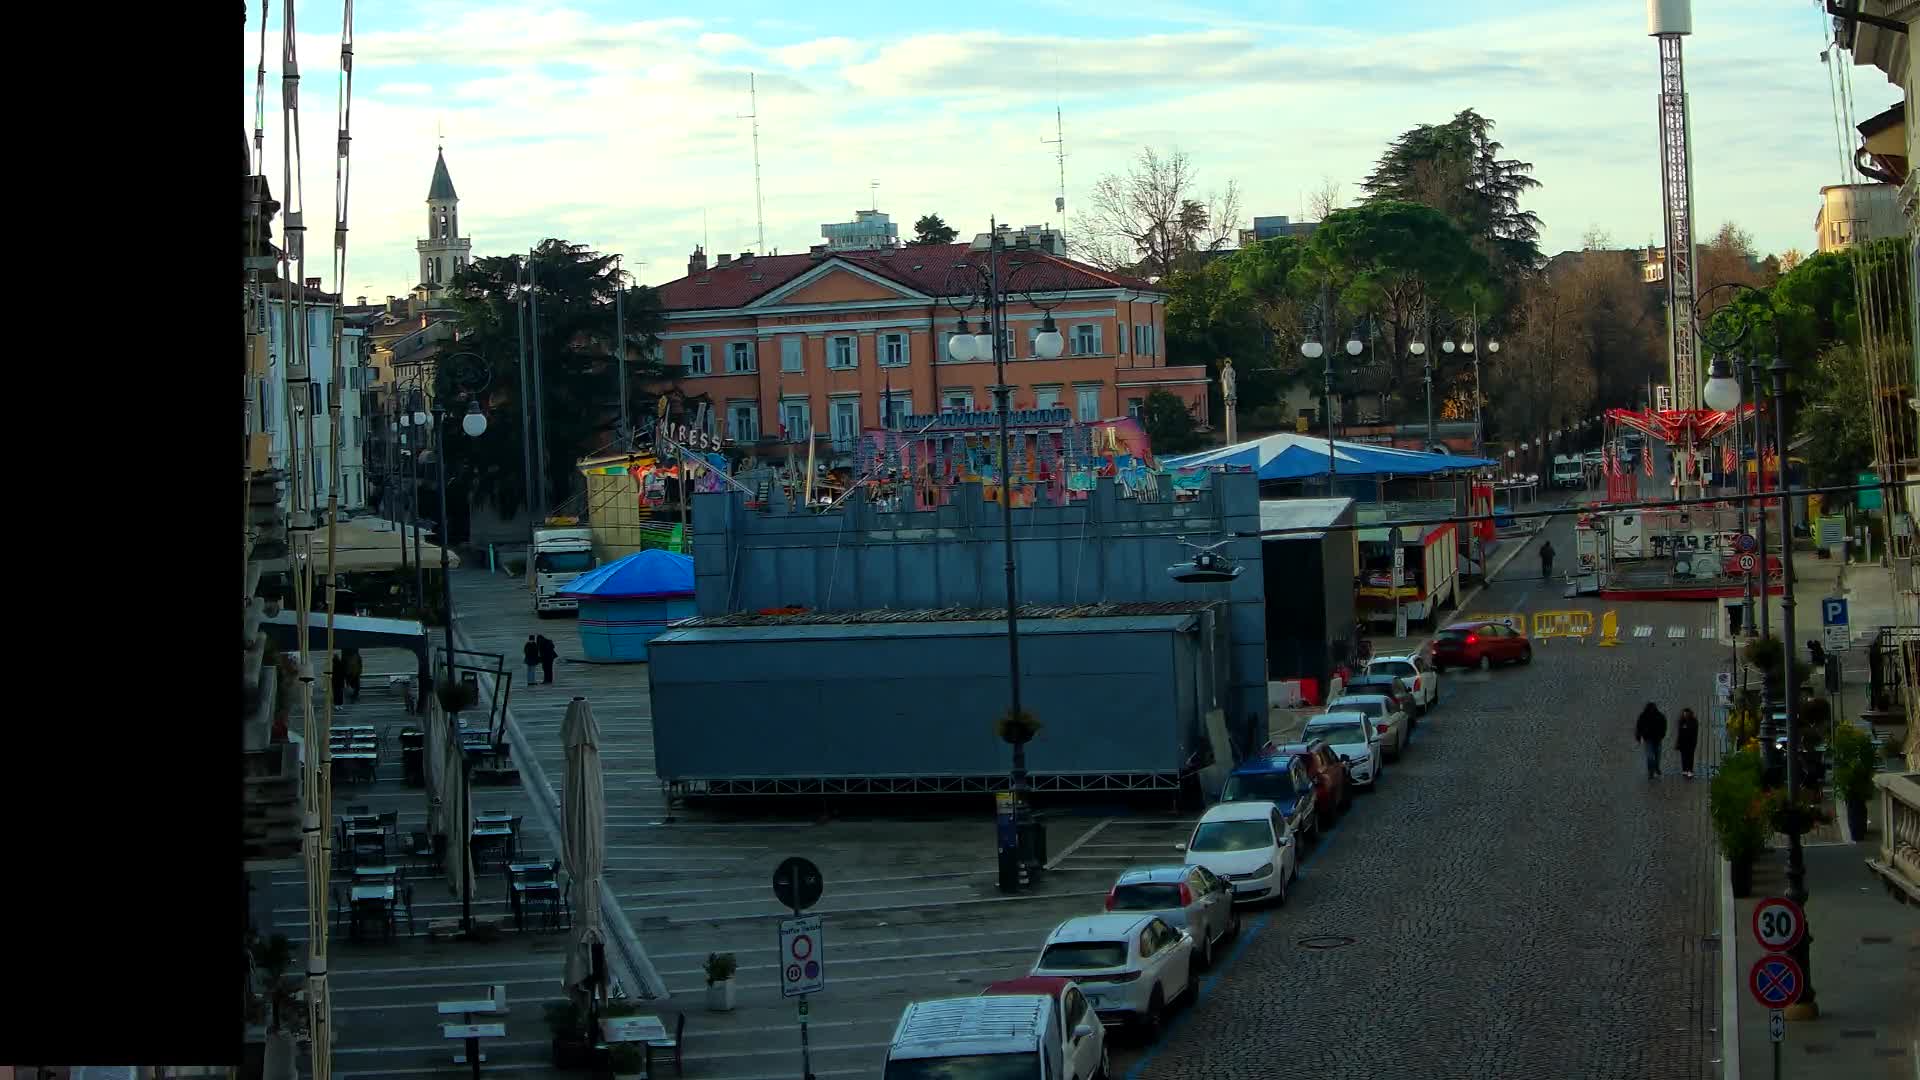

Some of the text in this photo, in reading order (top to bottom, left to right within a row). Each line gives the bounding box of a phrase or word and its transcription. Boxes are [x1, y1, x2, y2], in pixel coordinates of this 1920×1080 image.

[1743, 557, 1753, 567] 20
[1827, 602, 1842, 622] P
[1762, 911, 1792, 938] 30
